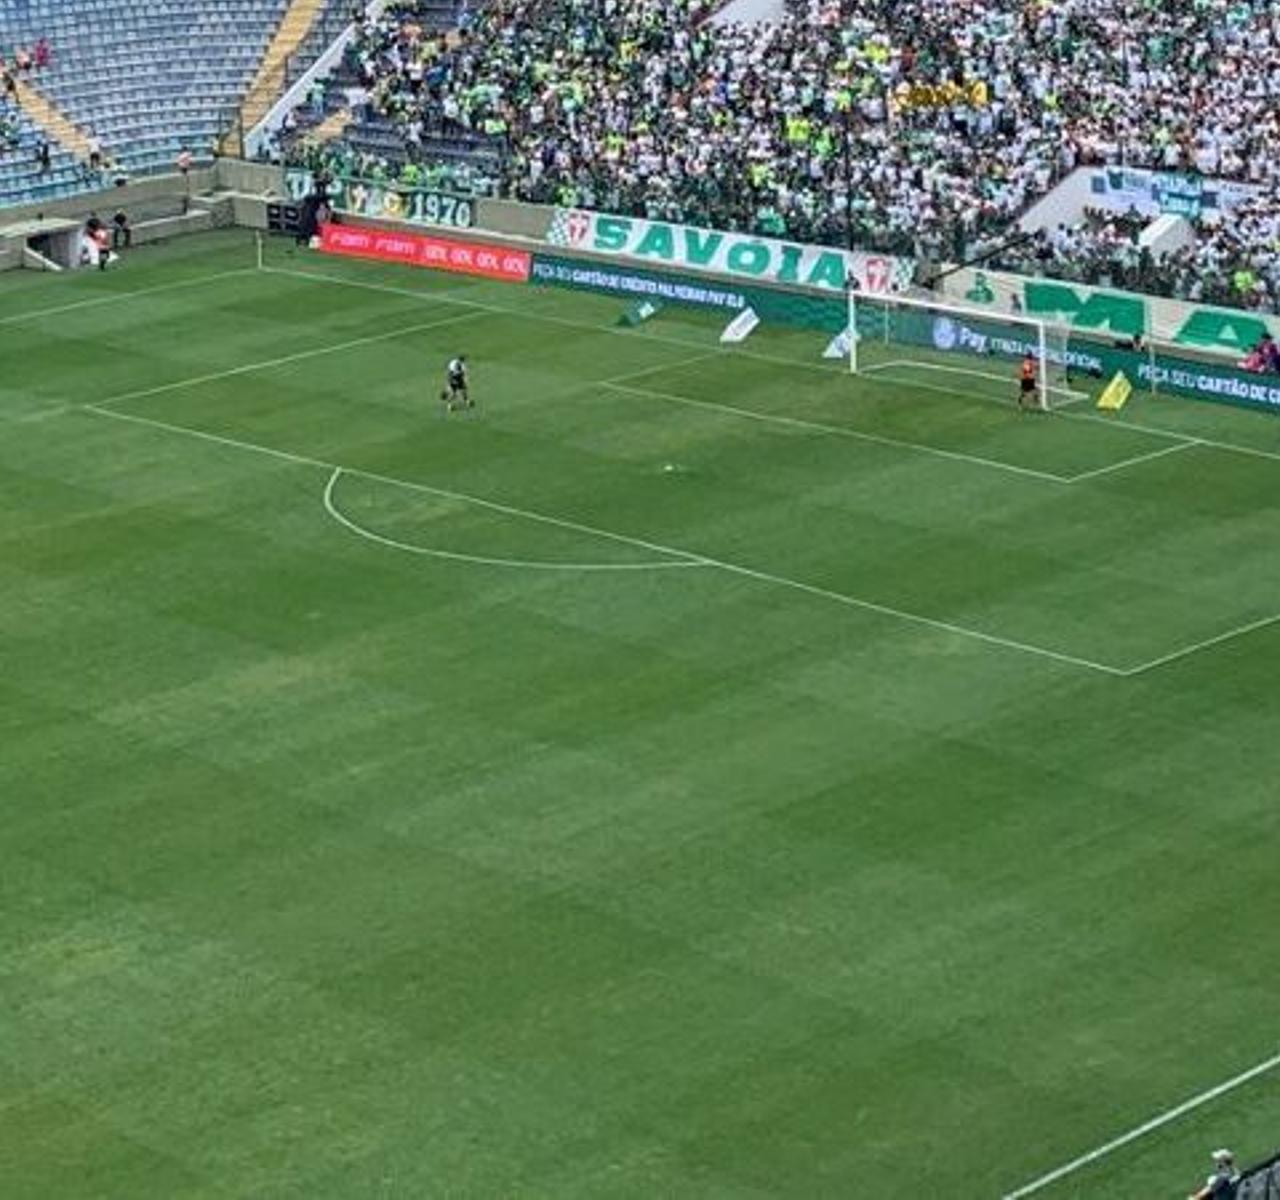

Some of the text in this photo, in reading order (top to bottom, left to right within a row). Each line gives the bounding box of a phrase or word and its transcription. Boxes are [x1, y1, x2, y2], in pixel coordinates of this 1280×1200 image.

[413, 194, 471, 228] 1970
[960, 327, 987, 352] Pay
[1172, 370, 1196, 388] SEU
[1197, 374, 1249, 398] CARTÃO
[1251, 384, 1267, 401] DE
